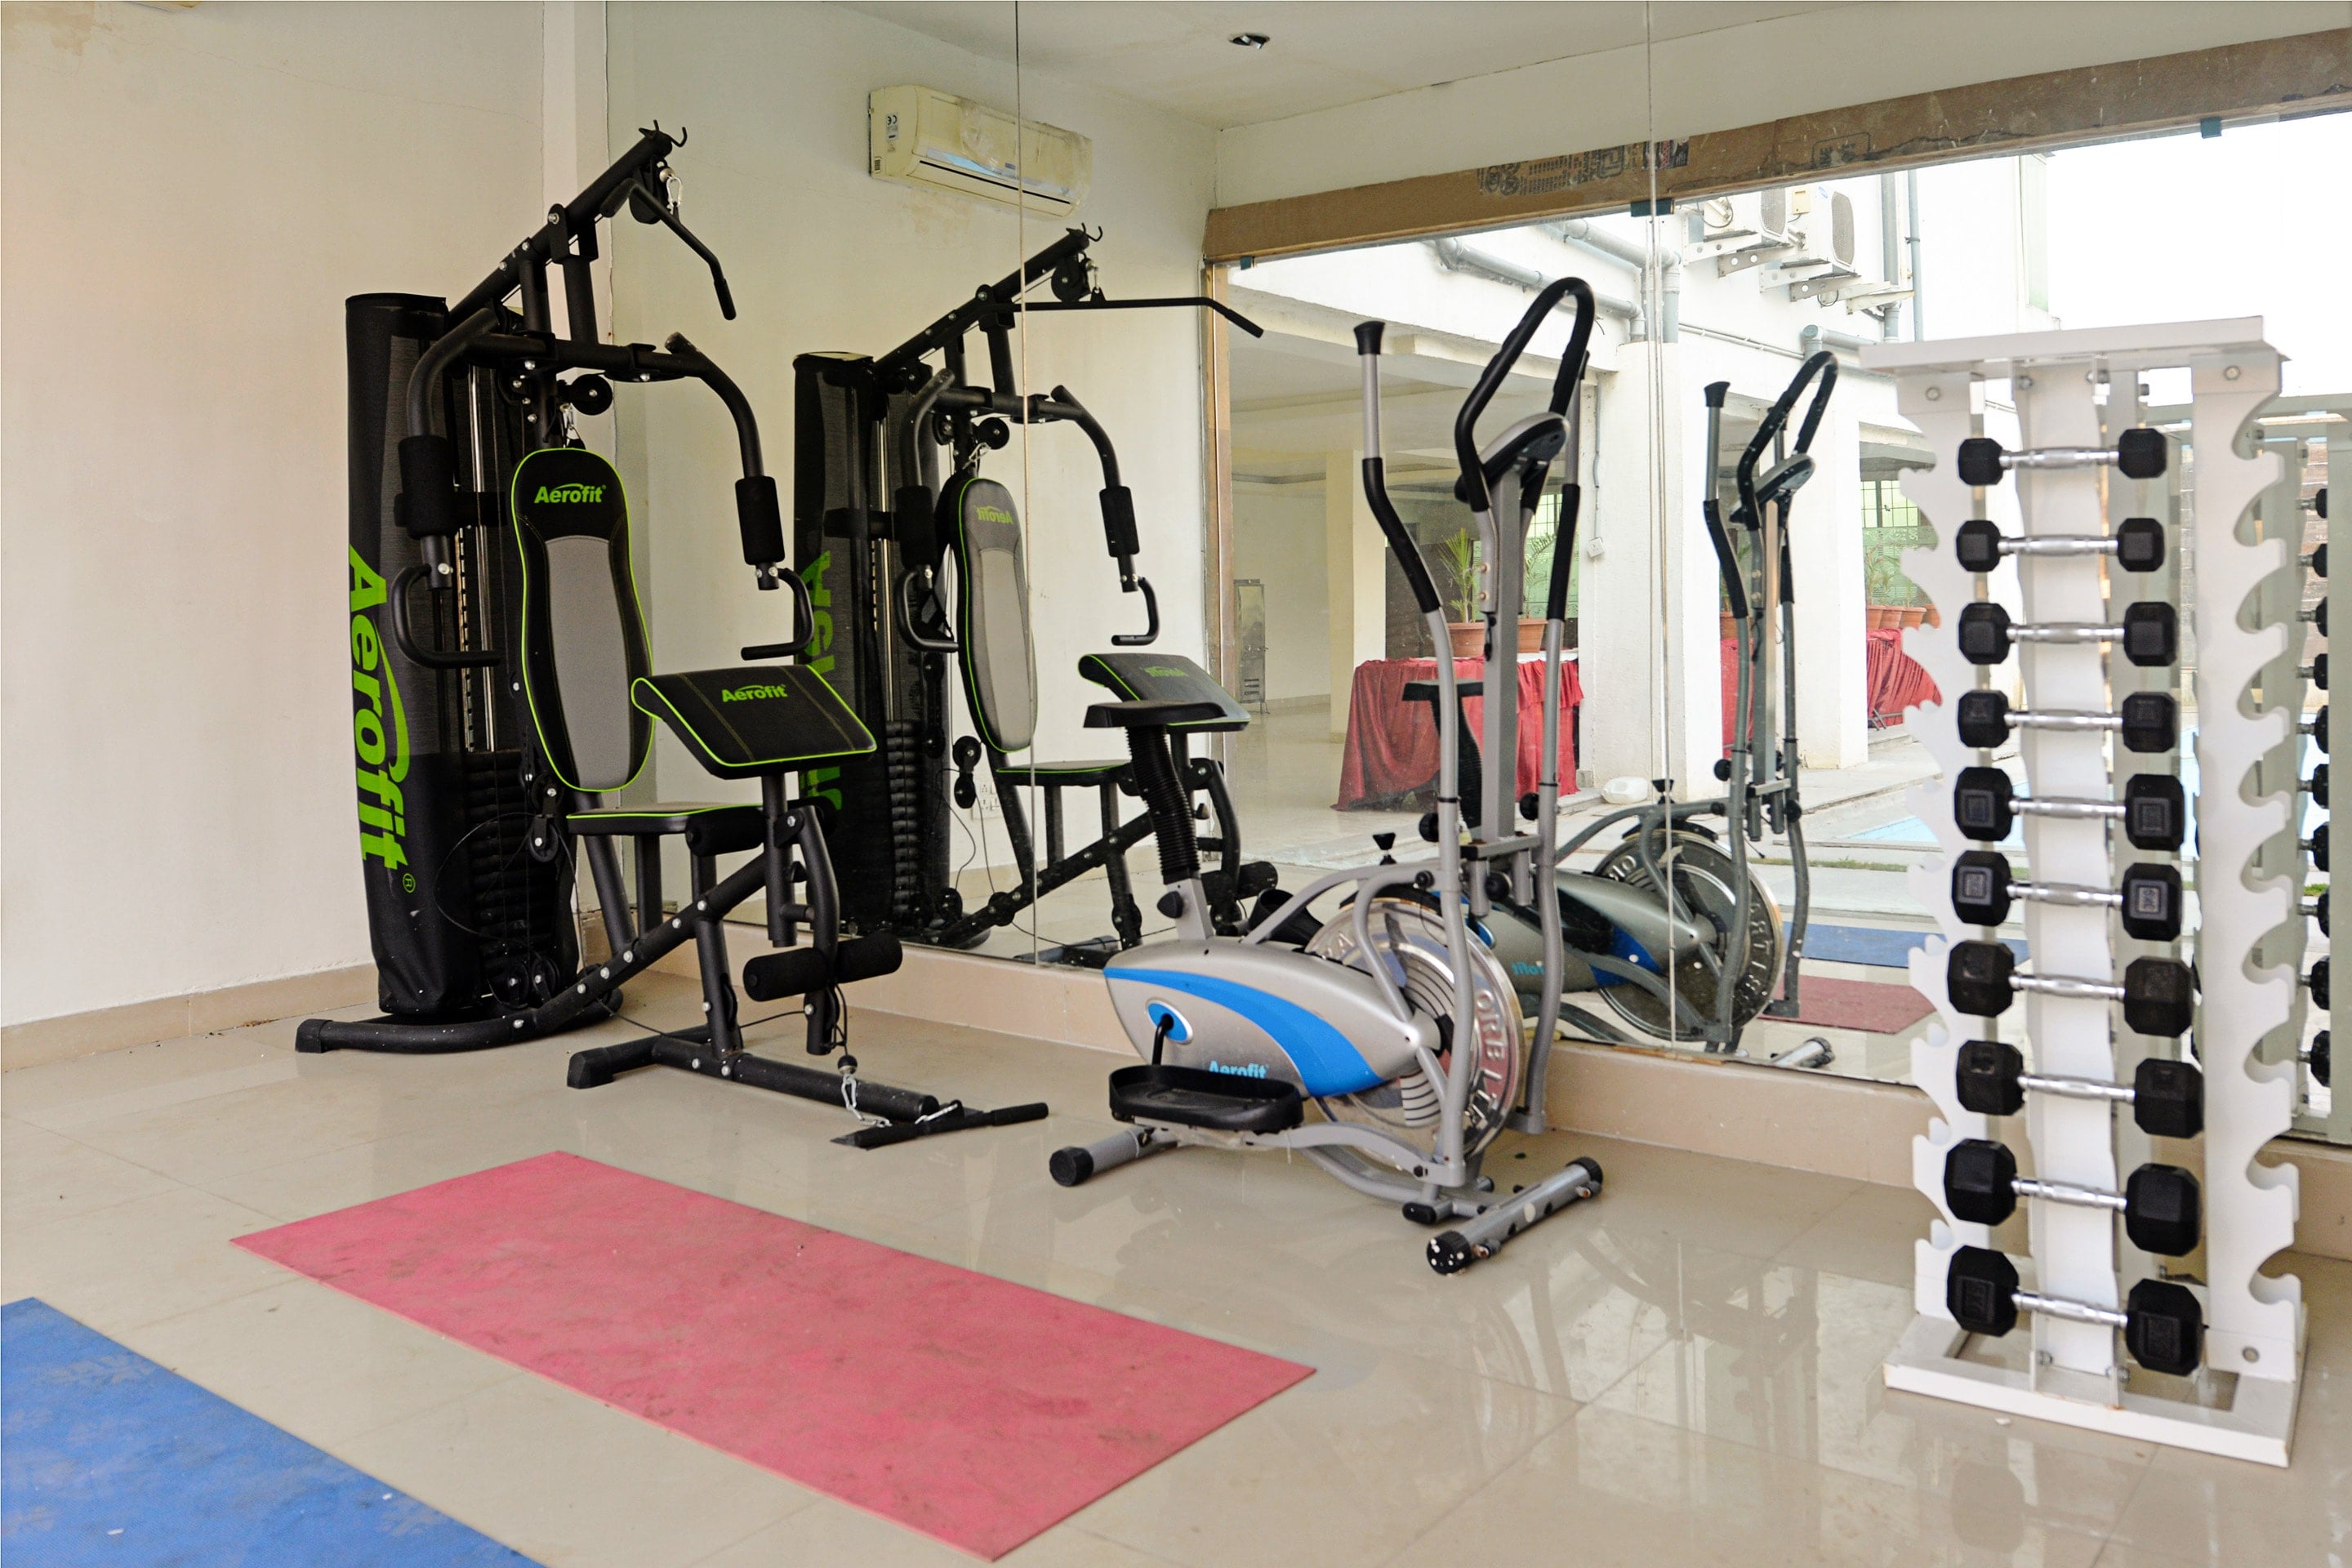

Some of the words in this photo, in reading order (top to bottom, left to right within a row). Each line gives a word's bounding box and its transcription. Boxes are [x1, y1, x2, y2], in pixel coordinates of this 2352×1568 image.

[534, 483, 603, 504] Aerofit
[722, 684, 788, 702] Aerofit
[349, 544, 409, 871] Aerofit
